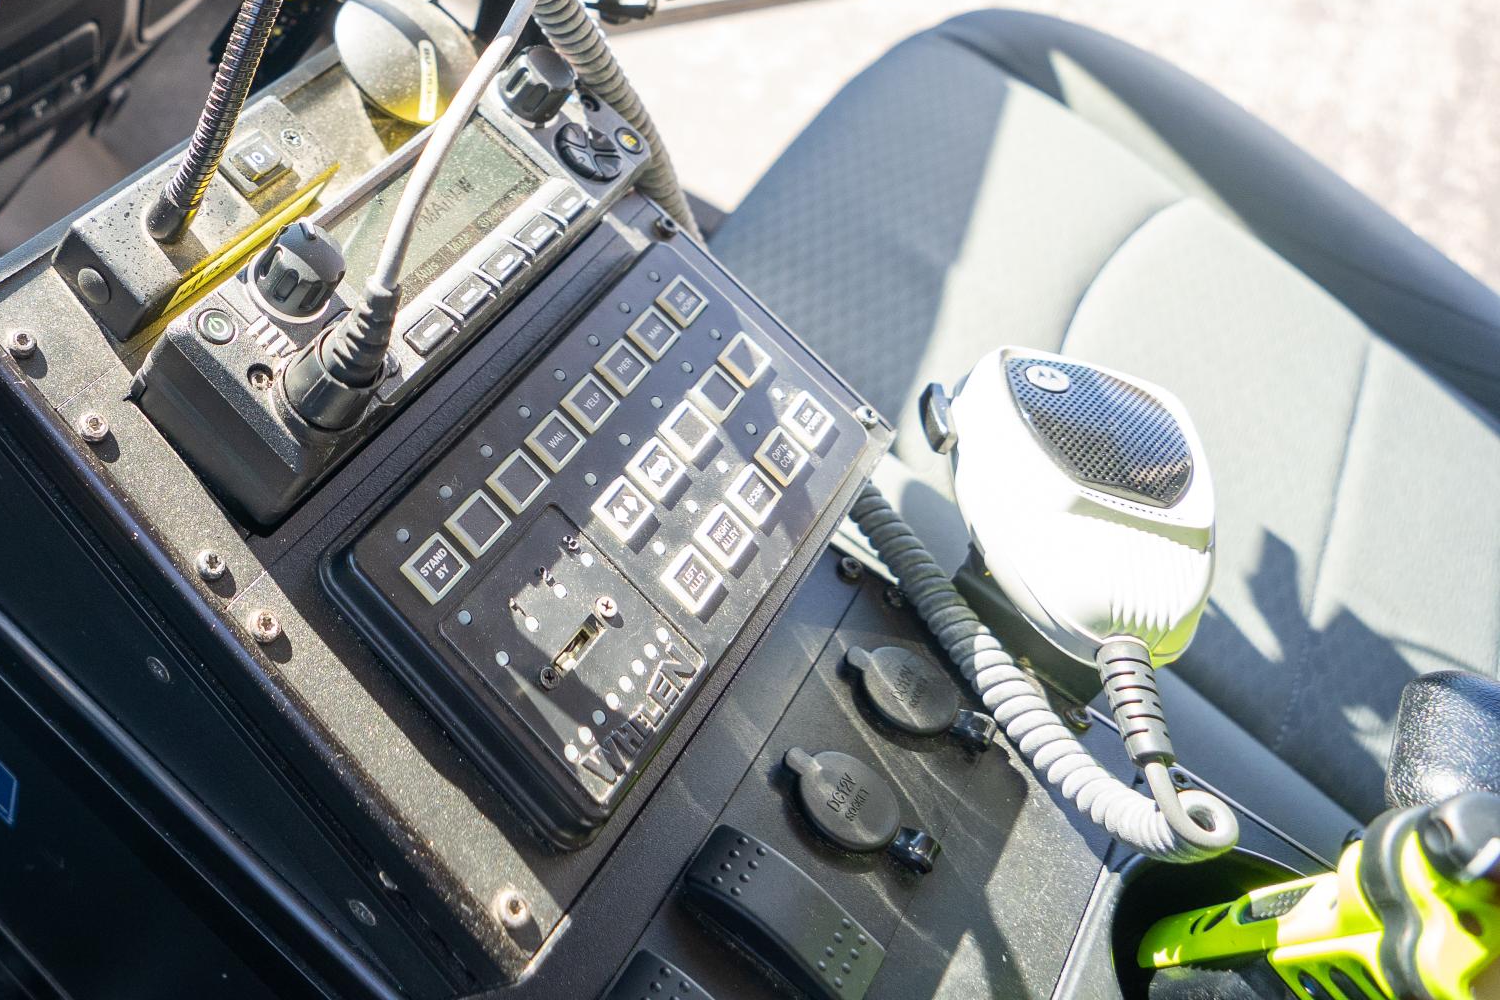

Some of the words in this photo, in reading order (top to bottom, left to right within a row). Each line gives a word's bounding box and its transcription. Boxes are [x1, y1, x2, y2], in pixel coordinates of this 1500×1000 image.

[616, 357, 633, 375] PIER
[583, 392, 601, 410] YELP
[547, 430, 567, 449] WAIL
[780, 450, 796, 468] COM
[747, 483, 766, 506] SCENE
[712, 519, 732, 542] RIGHT
[721, 527, 740, 551] ALLEY
[420, 547, 448, 577] STAND
[435, 563, 450, 580] BY
[683, 563, 698, 584] LEFT
[689, 571, 707, 594] ALLEY
[579, 642, 698, 785] WHELEN
[826, 772, 856, 812] DC12V
